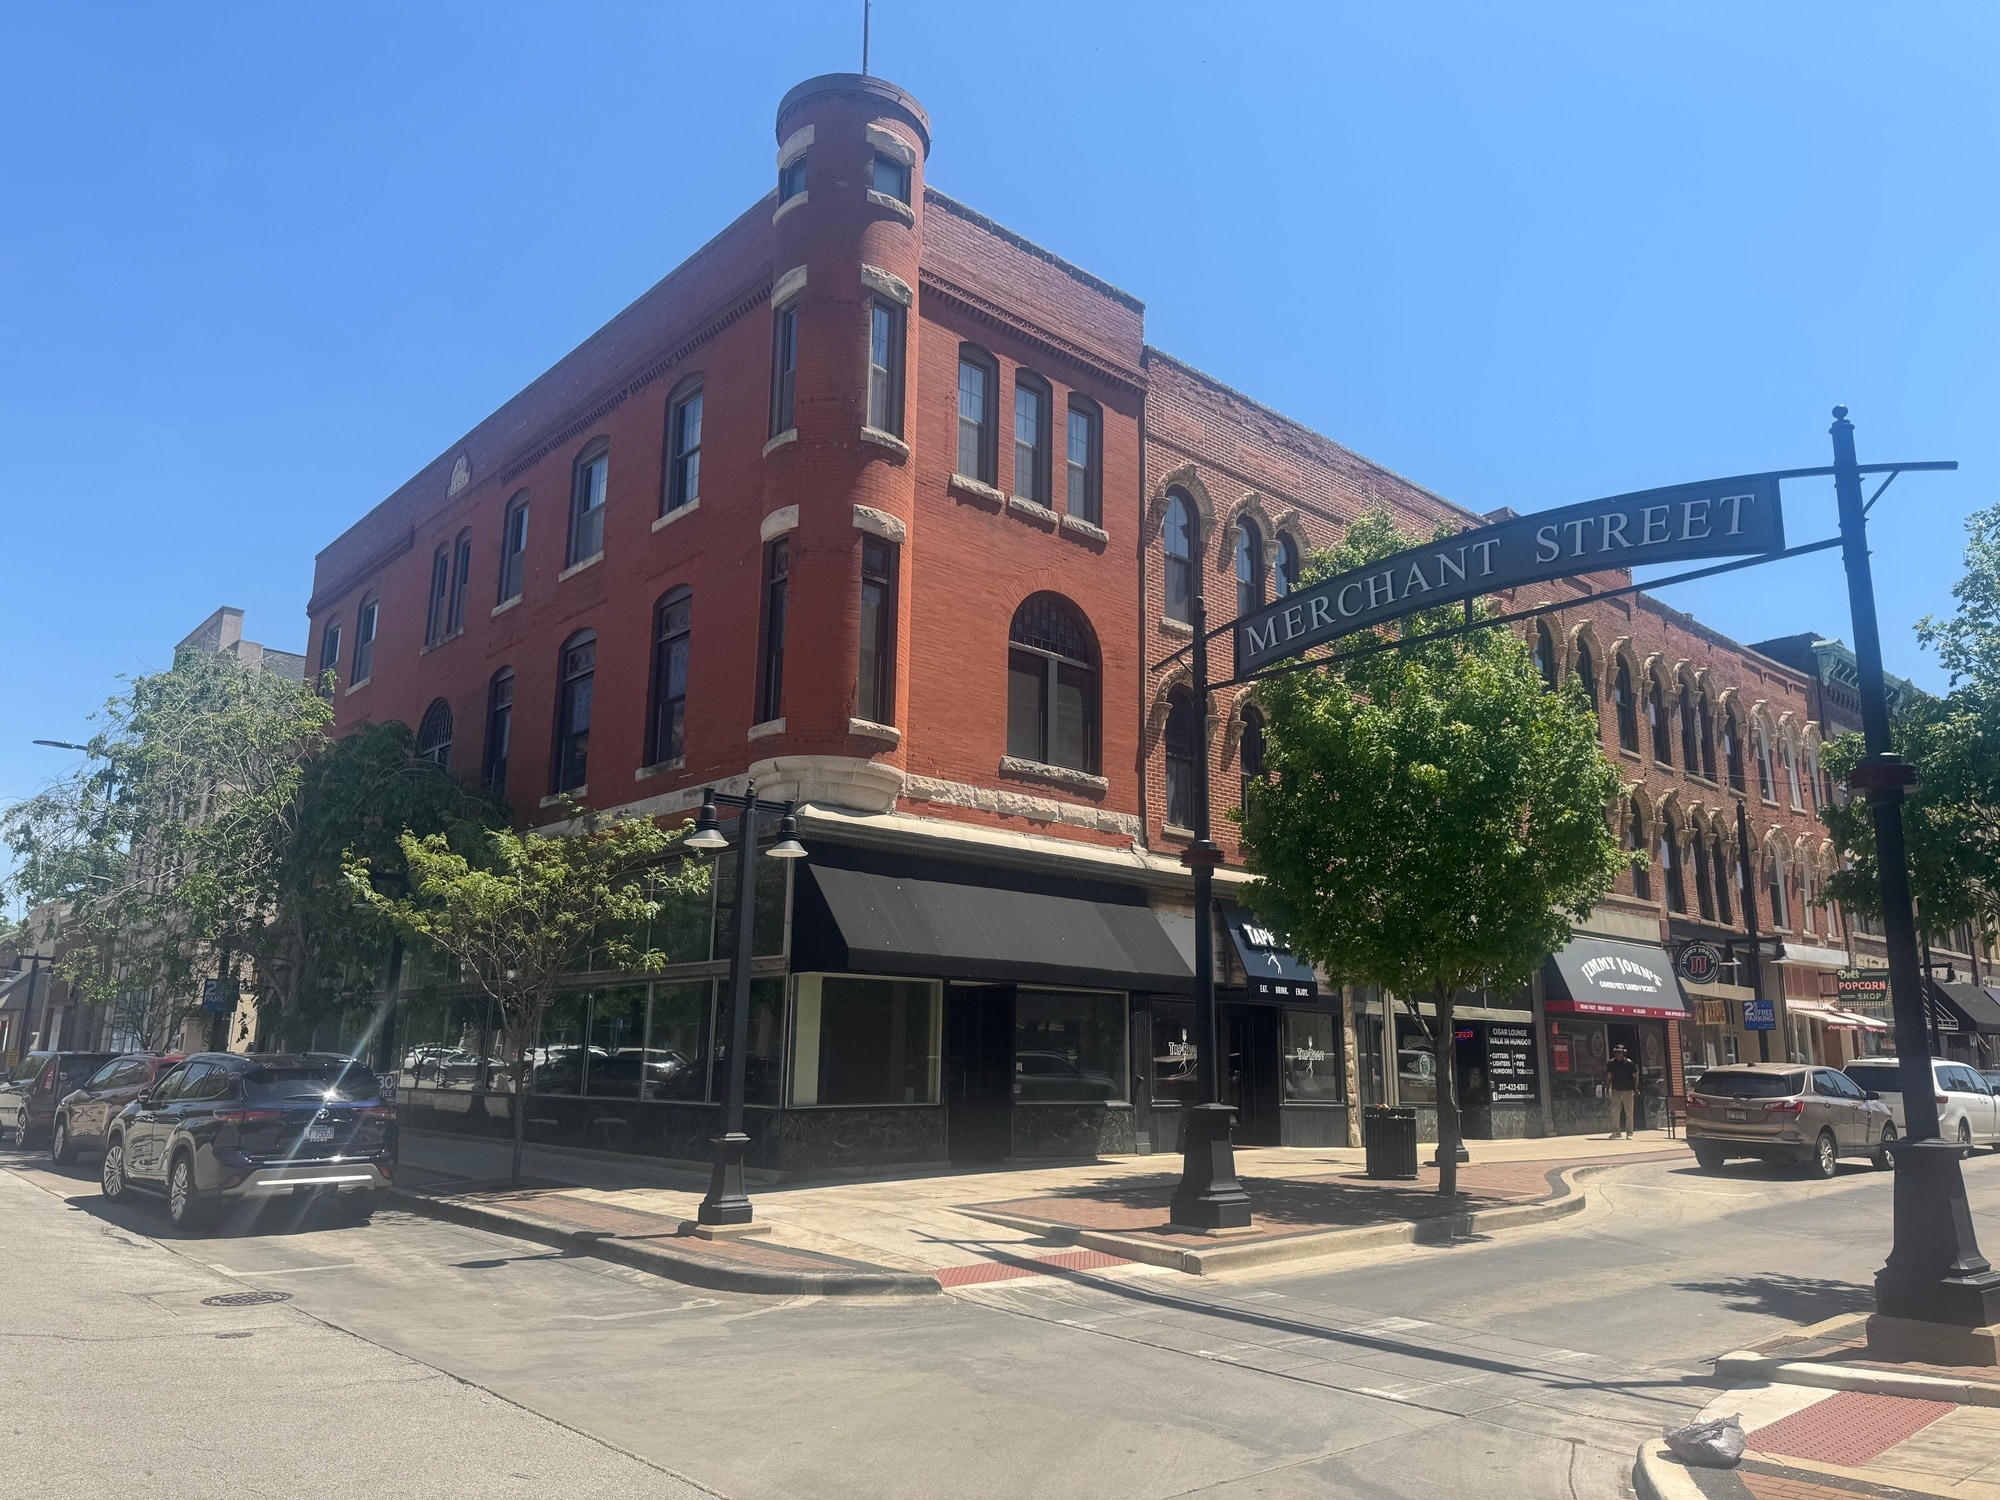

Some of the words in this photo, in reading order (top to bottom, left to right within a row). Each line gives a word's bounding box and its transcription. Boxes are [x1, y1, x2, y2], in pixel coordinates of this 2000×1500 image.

[1245, 538, 1501, 657] MERCHANT
[1535, 494, 1755, 564] STREET
[1581, 956, 1617, 985] JIMMY
[1615, 957, 1663, 987] JOHN'S
[1690, 956, 1707, 973] JJ
[206, 980, 217, 996] 2
[1260, 984, 1269, 993] EAT.
[1839, 980, 1886, 990] POPCORN
[1857, 992, 1881, 1000] SHOP
[1744, 1002, 1754, 1016] 2
[1492, 1028, 1507, 1036] CIGAR
[1508, 1029, 1527, 1037] LOUNGE
[1504, 1037, 1509, 1045] IN
[1510, 1038, 1531, 1046] HUMIDOR
[376, 1075, 394, 1089] 30
